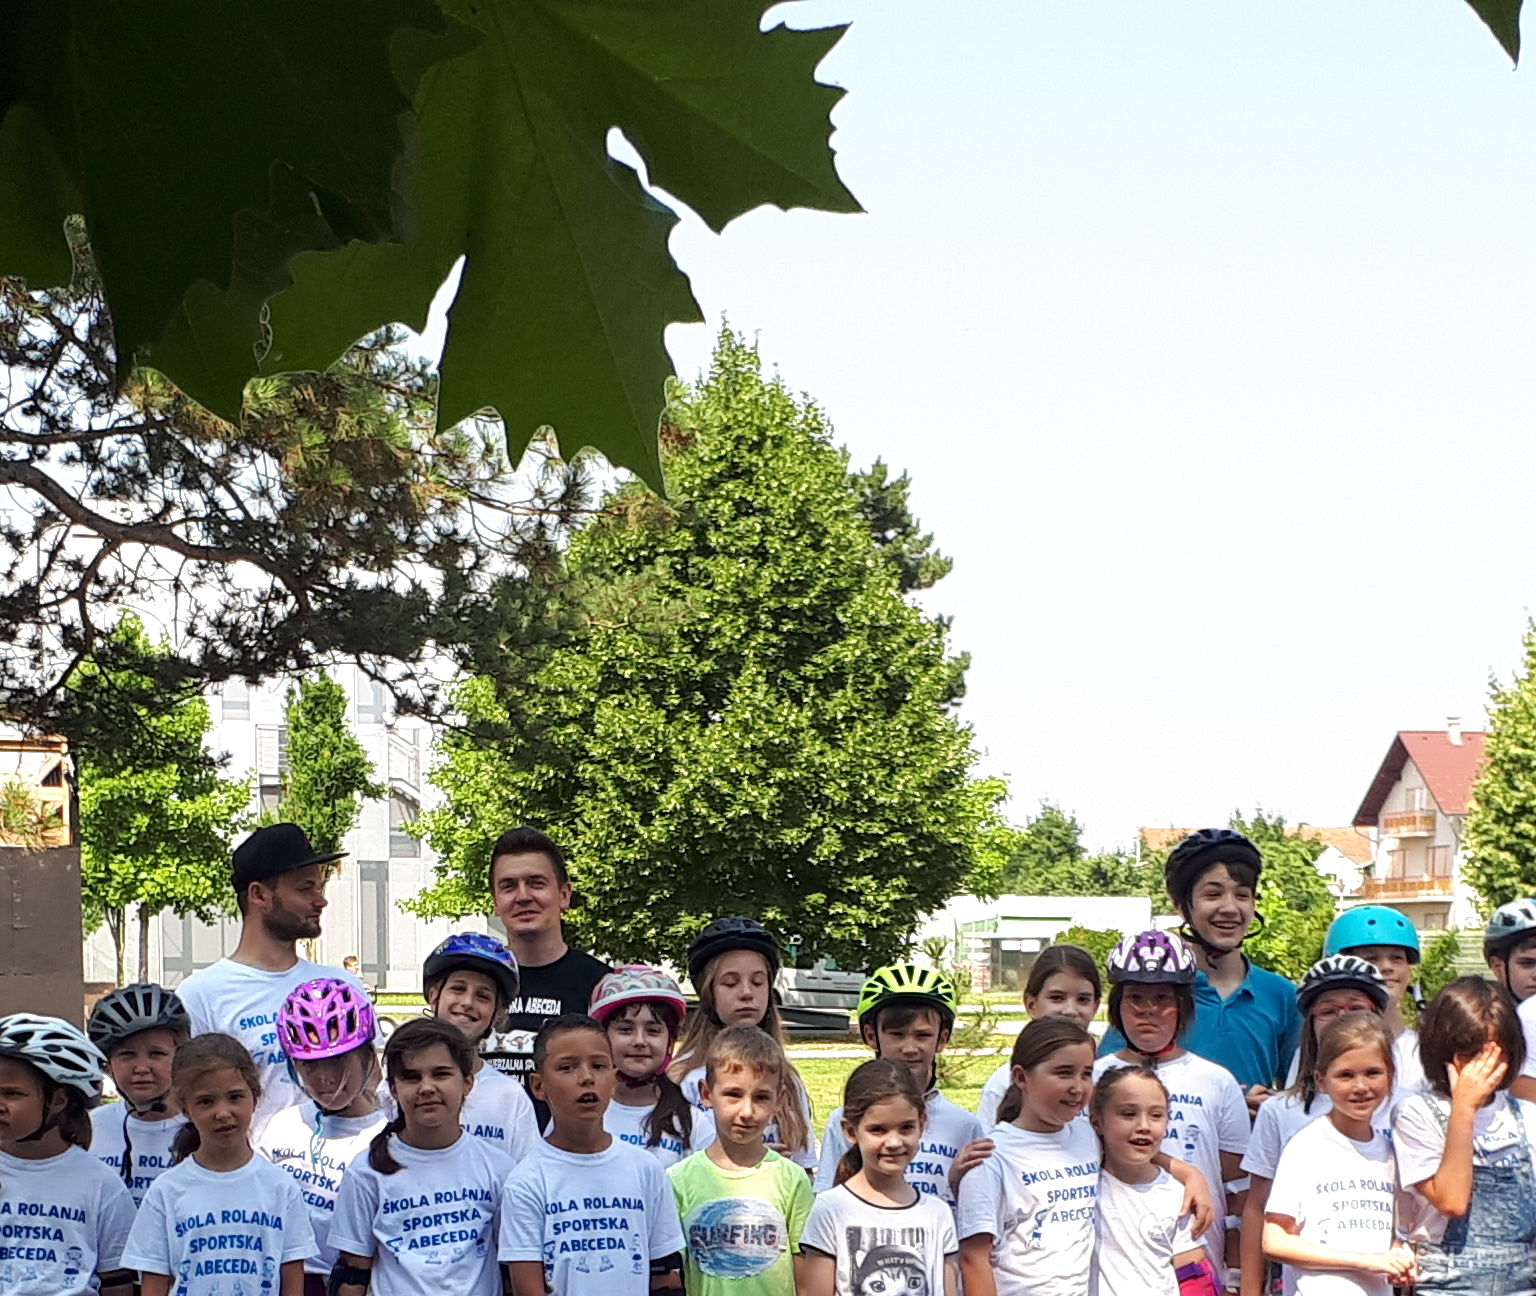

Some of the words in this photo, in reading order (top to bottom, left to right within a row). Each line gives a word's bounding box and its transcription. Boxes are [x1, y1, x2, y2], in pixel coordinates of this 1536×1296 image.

[1170, 1094, 1203, 1107] ANJA
[459, 1124, 504, 1140] LANJA
[620, 1134, 682, 1155] ROLNJA
[905, 1162, 944, 1176] TSKA
[1022, 1169, 1064, 1186] ŠKOLA
[1064, 1161, 1100, 1177] ROLAN
[301, 1189, 334, 1211] CEDA
[383, 1195, 429, 1214] ŠKOLA
[434, 1188, 492, 1204] ROLANJA
[1047, 1185, 1096, 1203] SPORTSK
[18, 1202, 86, 1224] ROLANJA
[545, 1200, 579, 1215] KOLA
[583, 1197, 644, 1211] ROLANJA
[403, 1208, 481, 1232] SPORTSKA
[552, 1217, 629, 1236] SPORTSKA
[189, 1234, 263, 1254] SPORTSKA
[408, 1228, 478, 1250] ABECEDA
[689, 1223, 777, 1246] SURFING
[559, 1237, 626, 1254] ABECEDA
[195, 1258, 258, 1277] ABECEDA
